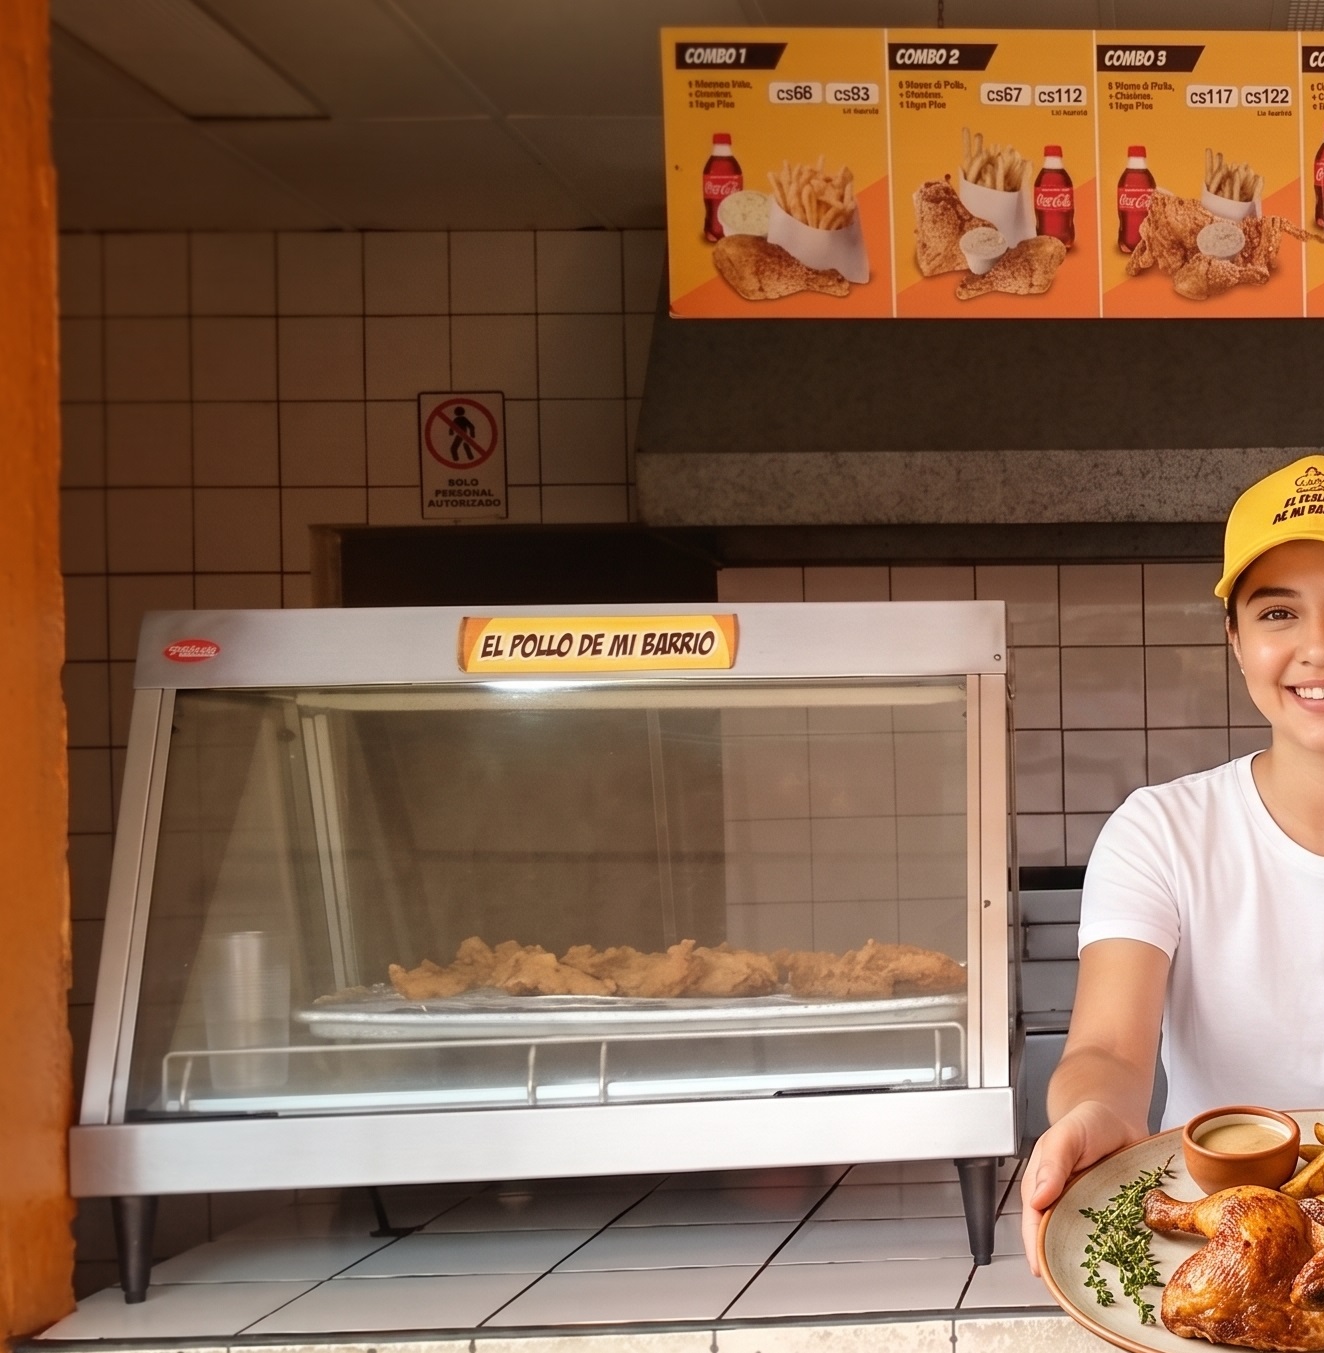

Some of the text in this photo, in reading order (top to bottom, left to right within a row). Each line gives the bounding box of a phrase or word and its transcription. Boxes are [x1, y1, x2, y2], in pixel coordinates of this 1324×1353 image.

[685, 48, 747, 64] COMBO 1
[896, 49, 960, 65] COMBO 2
[1105, 50, 1167, 66] COMBO 3
[987, 88, 1022, 102] cs67
[1038, 88, 1082, 103] cs112
[1190, 89, 1232, 104] cs117
[1245, 89, 1289, 104] cs122
[448, 479, 479, 487] SOLO
[435, 489, 494, 497] PERSONAL
[427, 499, 501, 508] AUTORIZADO
[1290, 506, 1306, 519] MI
[481, 630, 715, 658] EL POLLO DE MI BARRIO
